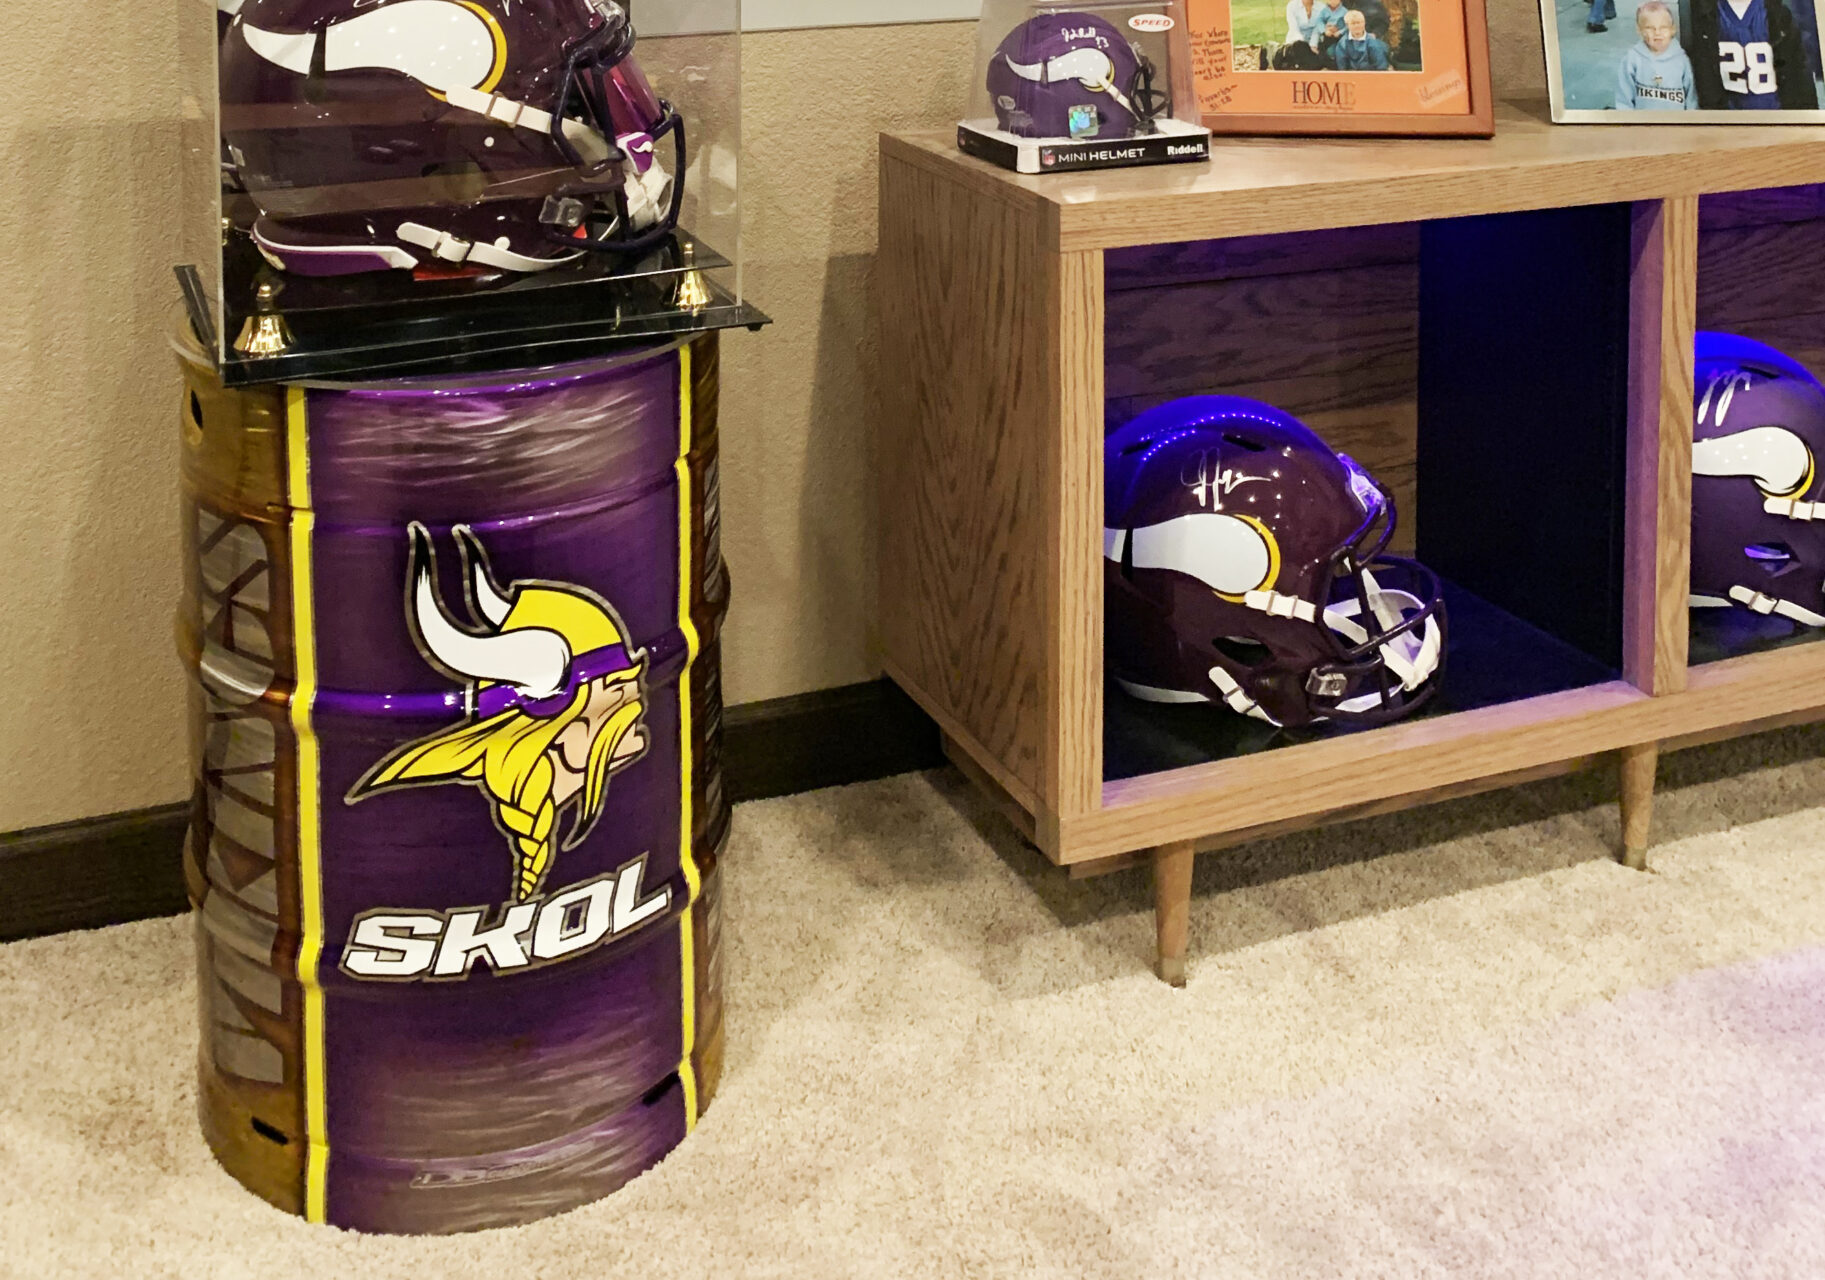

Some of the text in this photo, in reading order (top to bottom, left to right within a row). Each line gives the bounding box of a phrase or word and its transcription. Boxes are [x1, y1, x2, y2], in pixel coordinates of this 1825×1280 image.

[1133, 18, 1171, 26] SPEED
[1718, 41, 1778, 95] 28
[1058, 153, 1087, 163] MINI
[1089, 147, 1146, 161] HELMET
[1167, 144, 1204, 156] Riddell
[345, 862, 669, 976] SKOL
